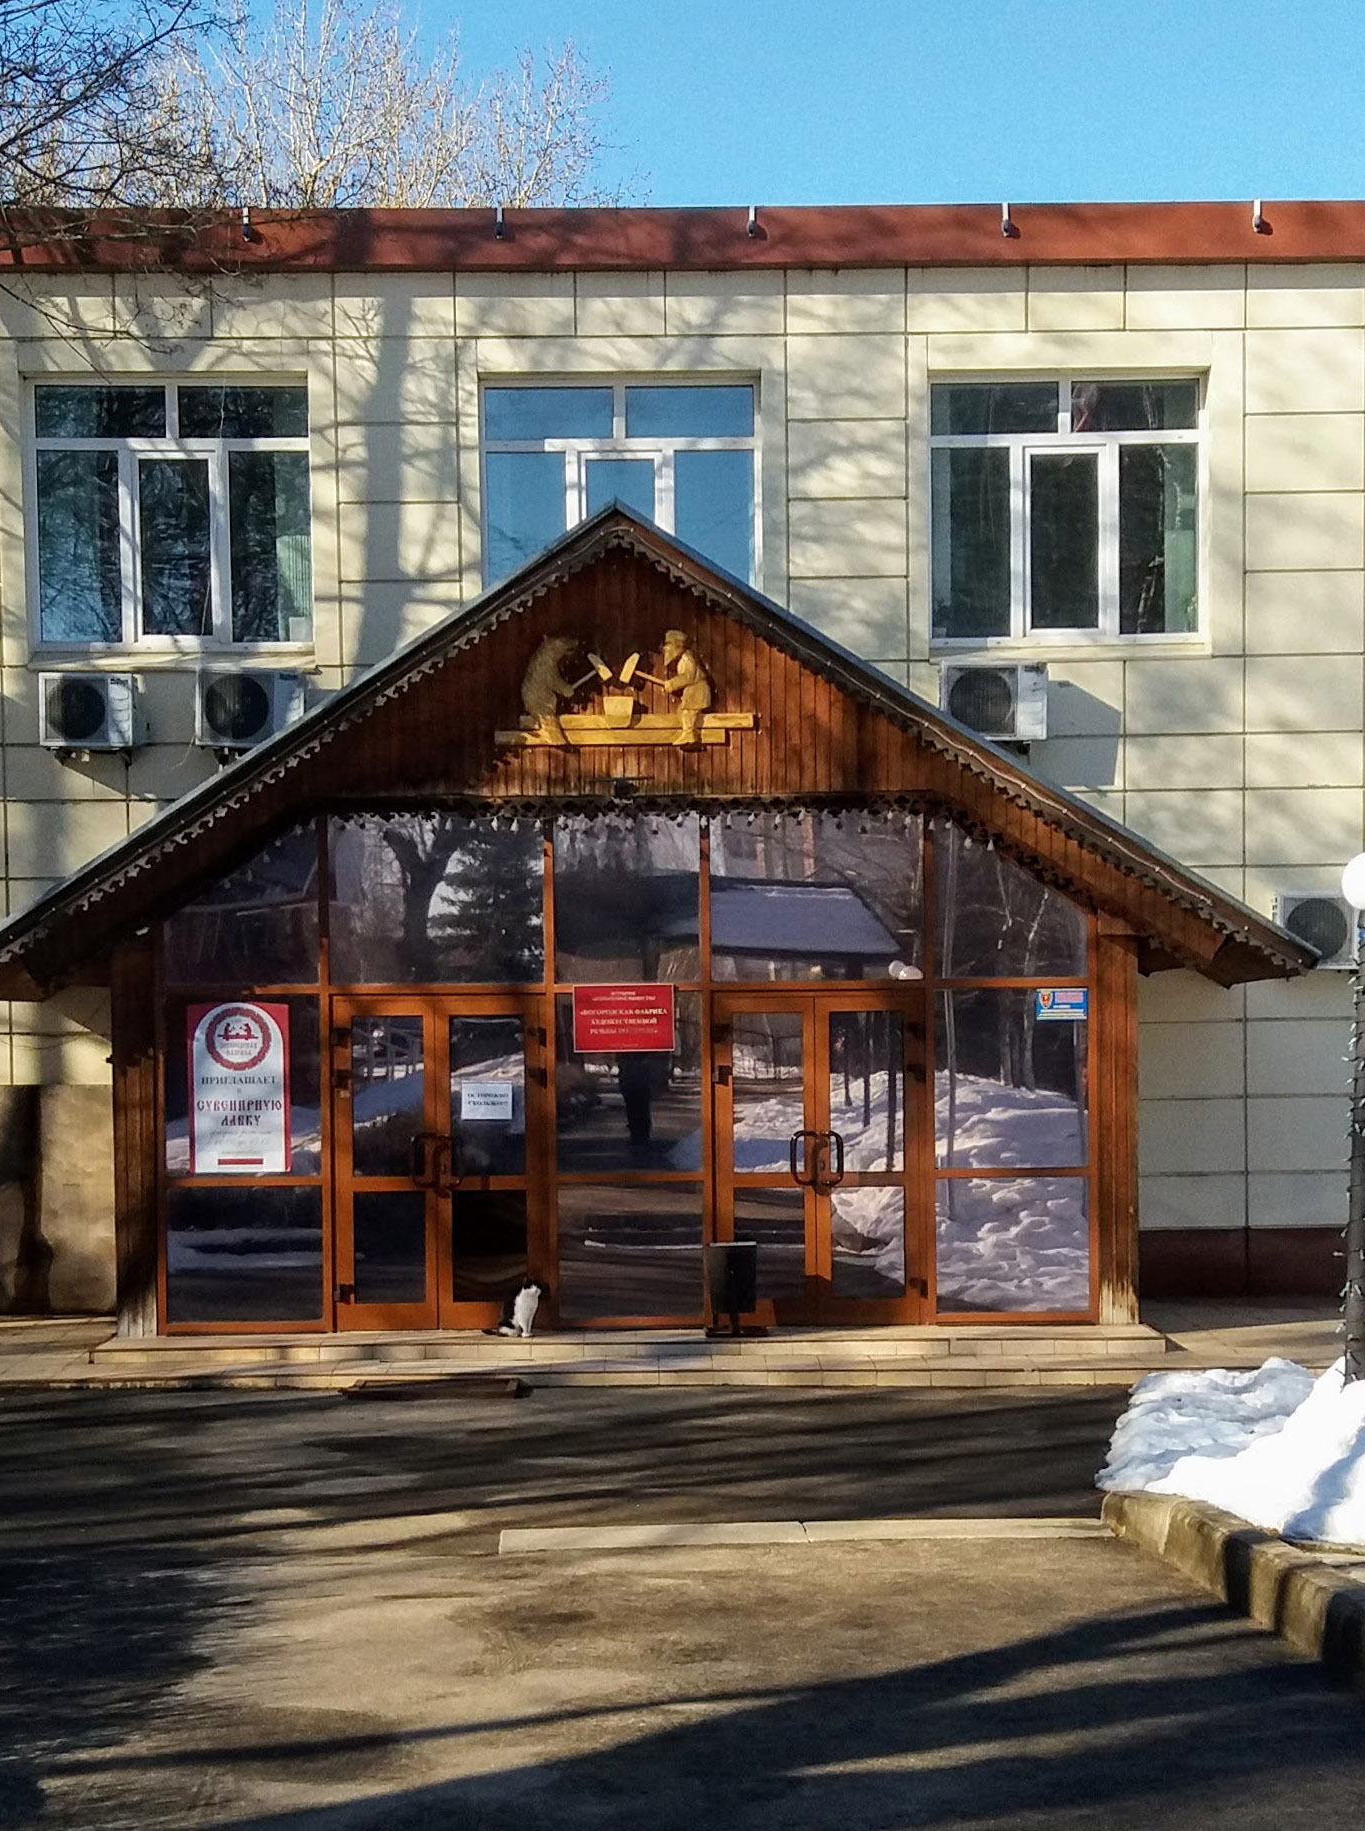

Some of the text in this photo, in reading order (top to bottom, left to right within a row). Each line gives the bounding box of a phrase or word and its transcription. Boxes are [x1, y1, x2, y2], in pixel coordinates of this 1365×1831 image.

[634, 1007, 668, 1015] ФАБРИКА
[201, 1076, 276, 1085] ПРИГЛАШАЕТ
[197, 1099, 283, 1112] СУВЕНИРНУЮ
[221, 1114, 261, 1126] ЛАВКУ
